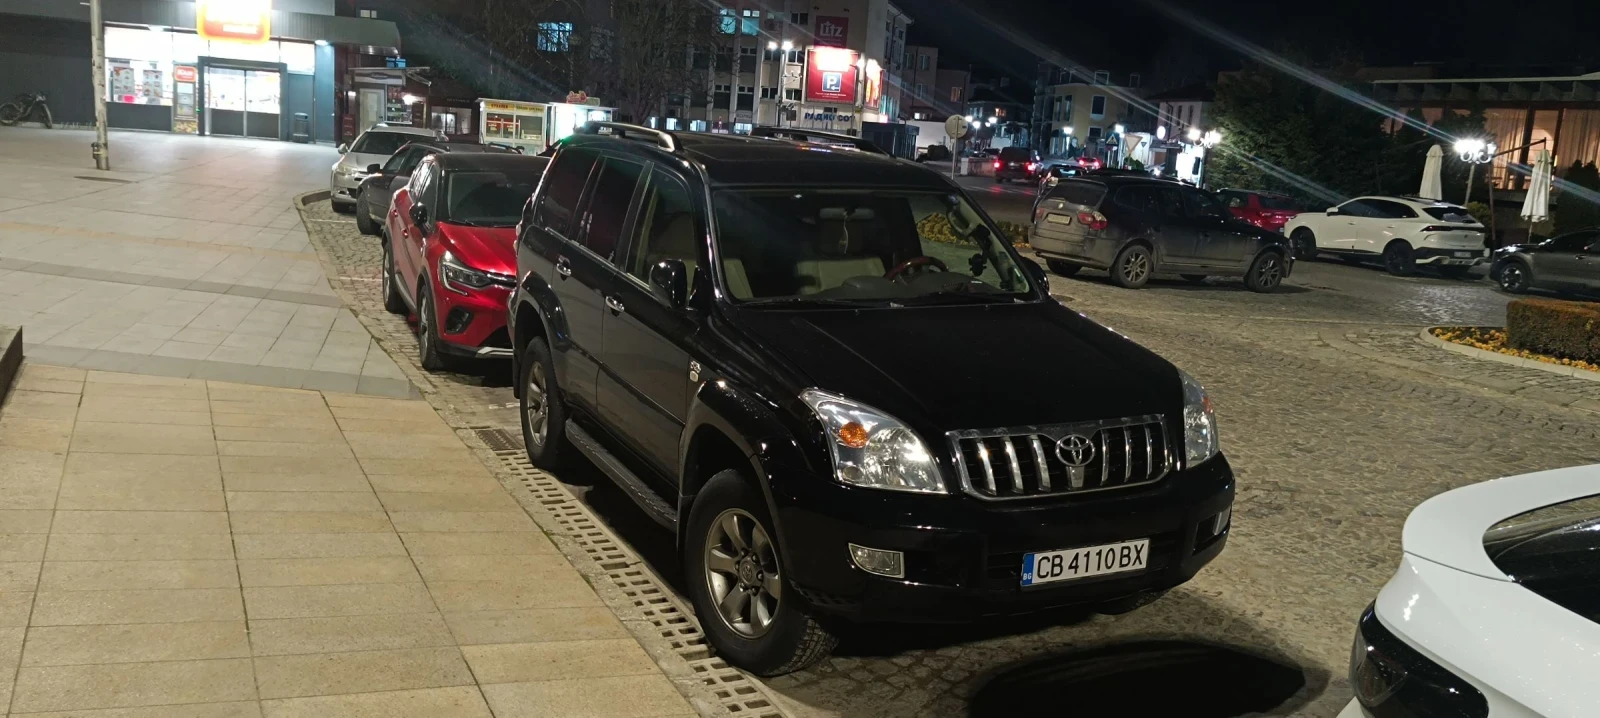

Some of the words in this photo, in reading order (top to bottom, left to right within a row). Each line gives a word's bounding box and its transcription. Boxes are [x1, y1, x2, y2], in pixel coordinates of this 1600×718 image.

[805, 112, 835, 121] РАДИО
[1037, 554, 1063, 579] CB
[1068, 548, 1116, 575] 4110
[1119, 543, 1145, 568] BX
[1022, 572, 1032, 581] BG
